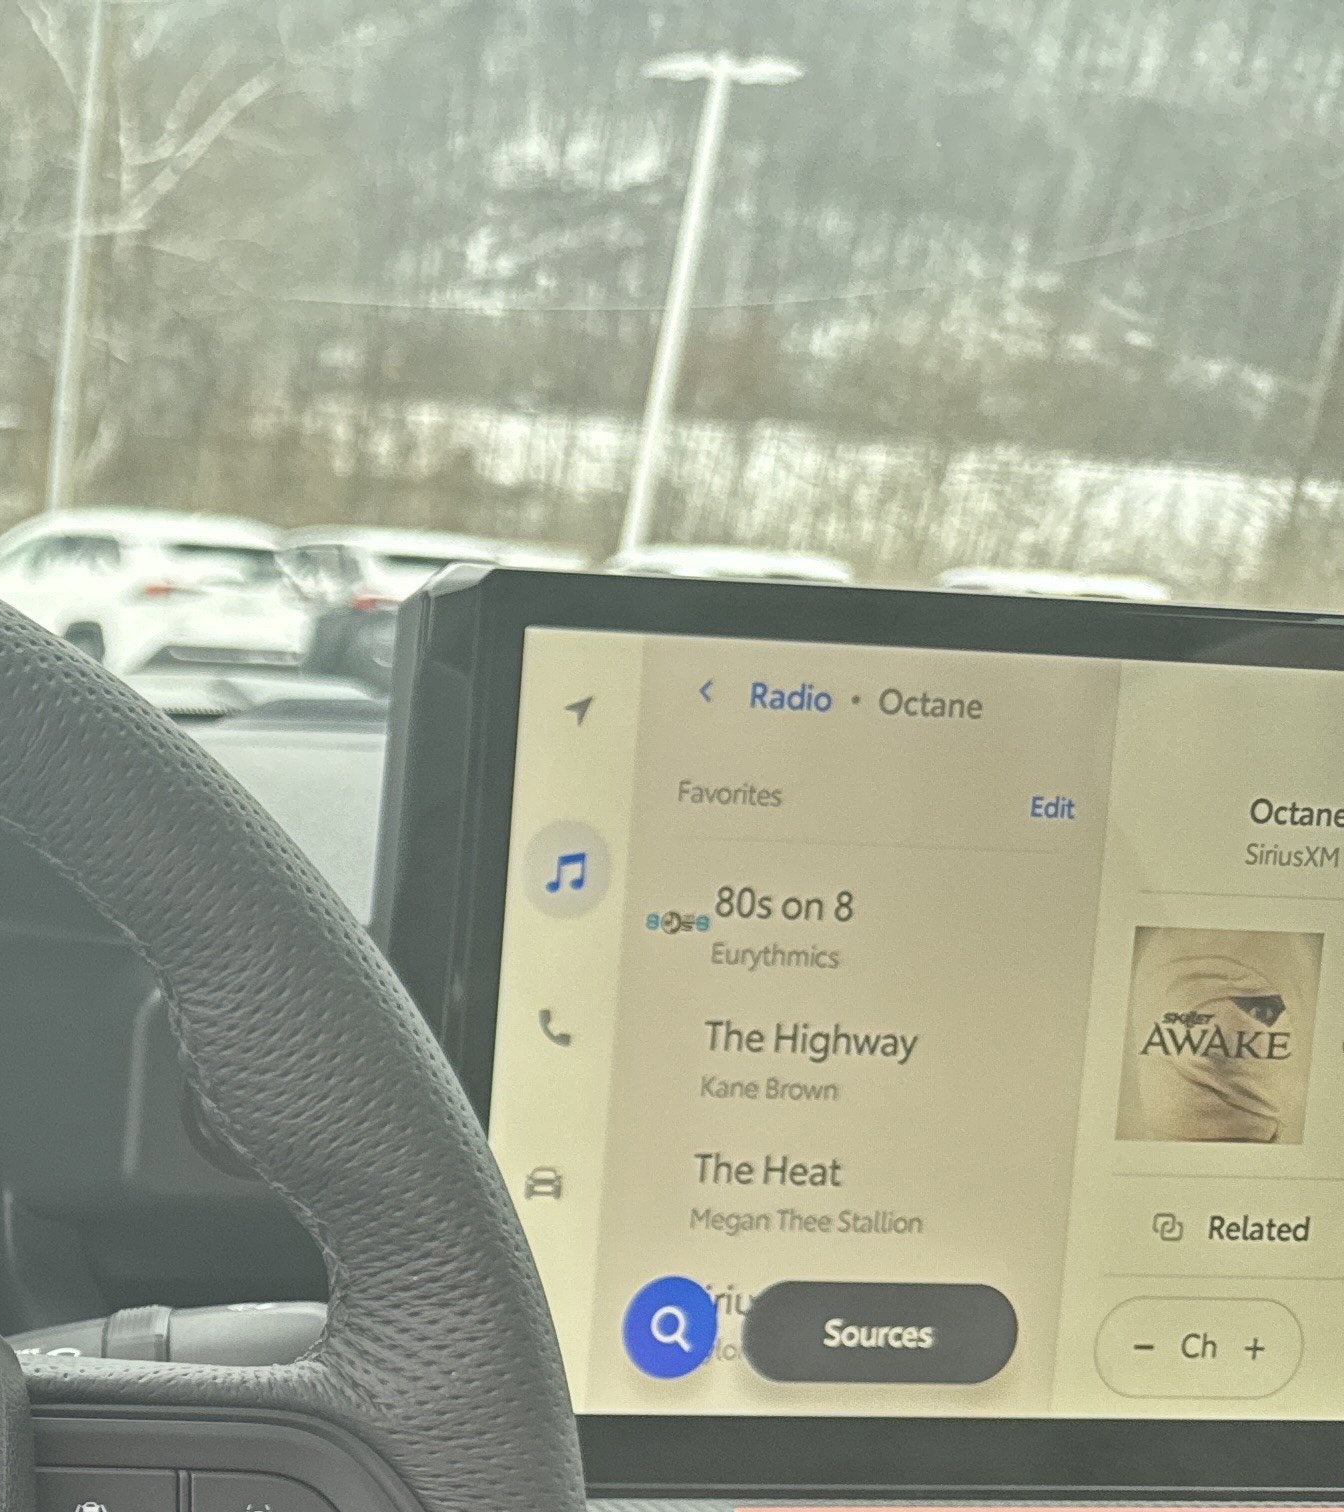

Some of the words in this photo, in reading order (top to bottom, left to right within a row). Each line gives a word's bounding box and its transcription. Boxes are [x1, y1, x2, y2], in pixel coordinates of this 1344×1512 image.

[749, 682, 833, 712] Radio
[878, 689, 984, 720] Octane
[678, 780, 784, 808] Favorites
[1030, 796, 1076, 821] Edit
[1250, 797, 1344, 828] Octane
[1245, 842, 1340, 868] SiriusXM
[715, 886, 773, 921] 80s
[781, 895, 824, 922] on
[834, 890, 856, 923] 8
[711, 941, 841, 972] Eurythmics
[705, 1021, 765, 1055] The
[773, 1022, 919, 1066] Highway
[1138, 1021, 1292, 1060] AWAKE
[700, 1076, 759, 1101] Kane
[765, 1078, 840, 1103] Brown
[695, 1154, 755, 1186] The
[763, 1156, 843, 1188] Heat
[690, 1208, 770, 1237] Megan
[777, 1209, 831, 1234] Thee
[838, 1209, 924, 1235] Stallion
[1208, 1214, 1311, 1244] Related
[823, 1317, 936, 1350] Sources
[1181, 1334, 1219, 1360] Ch
